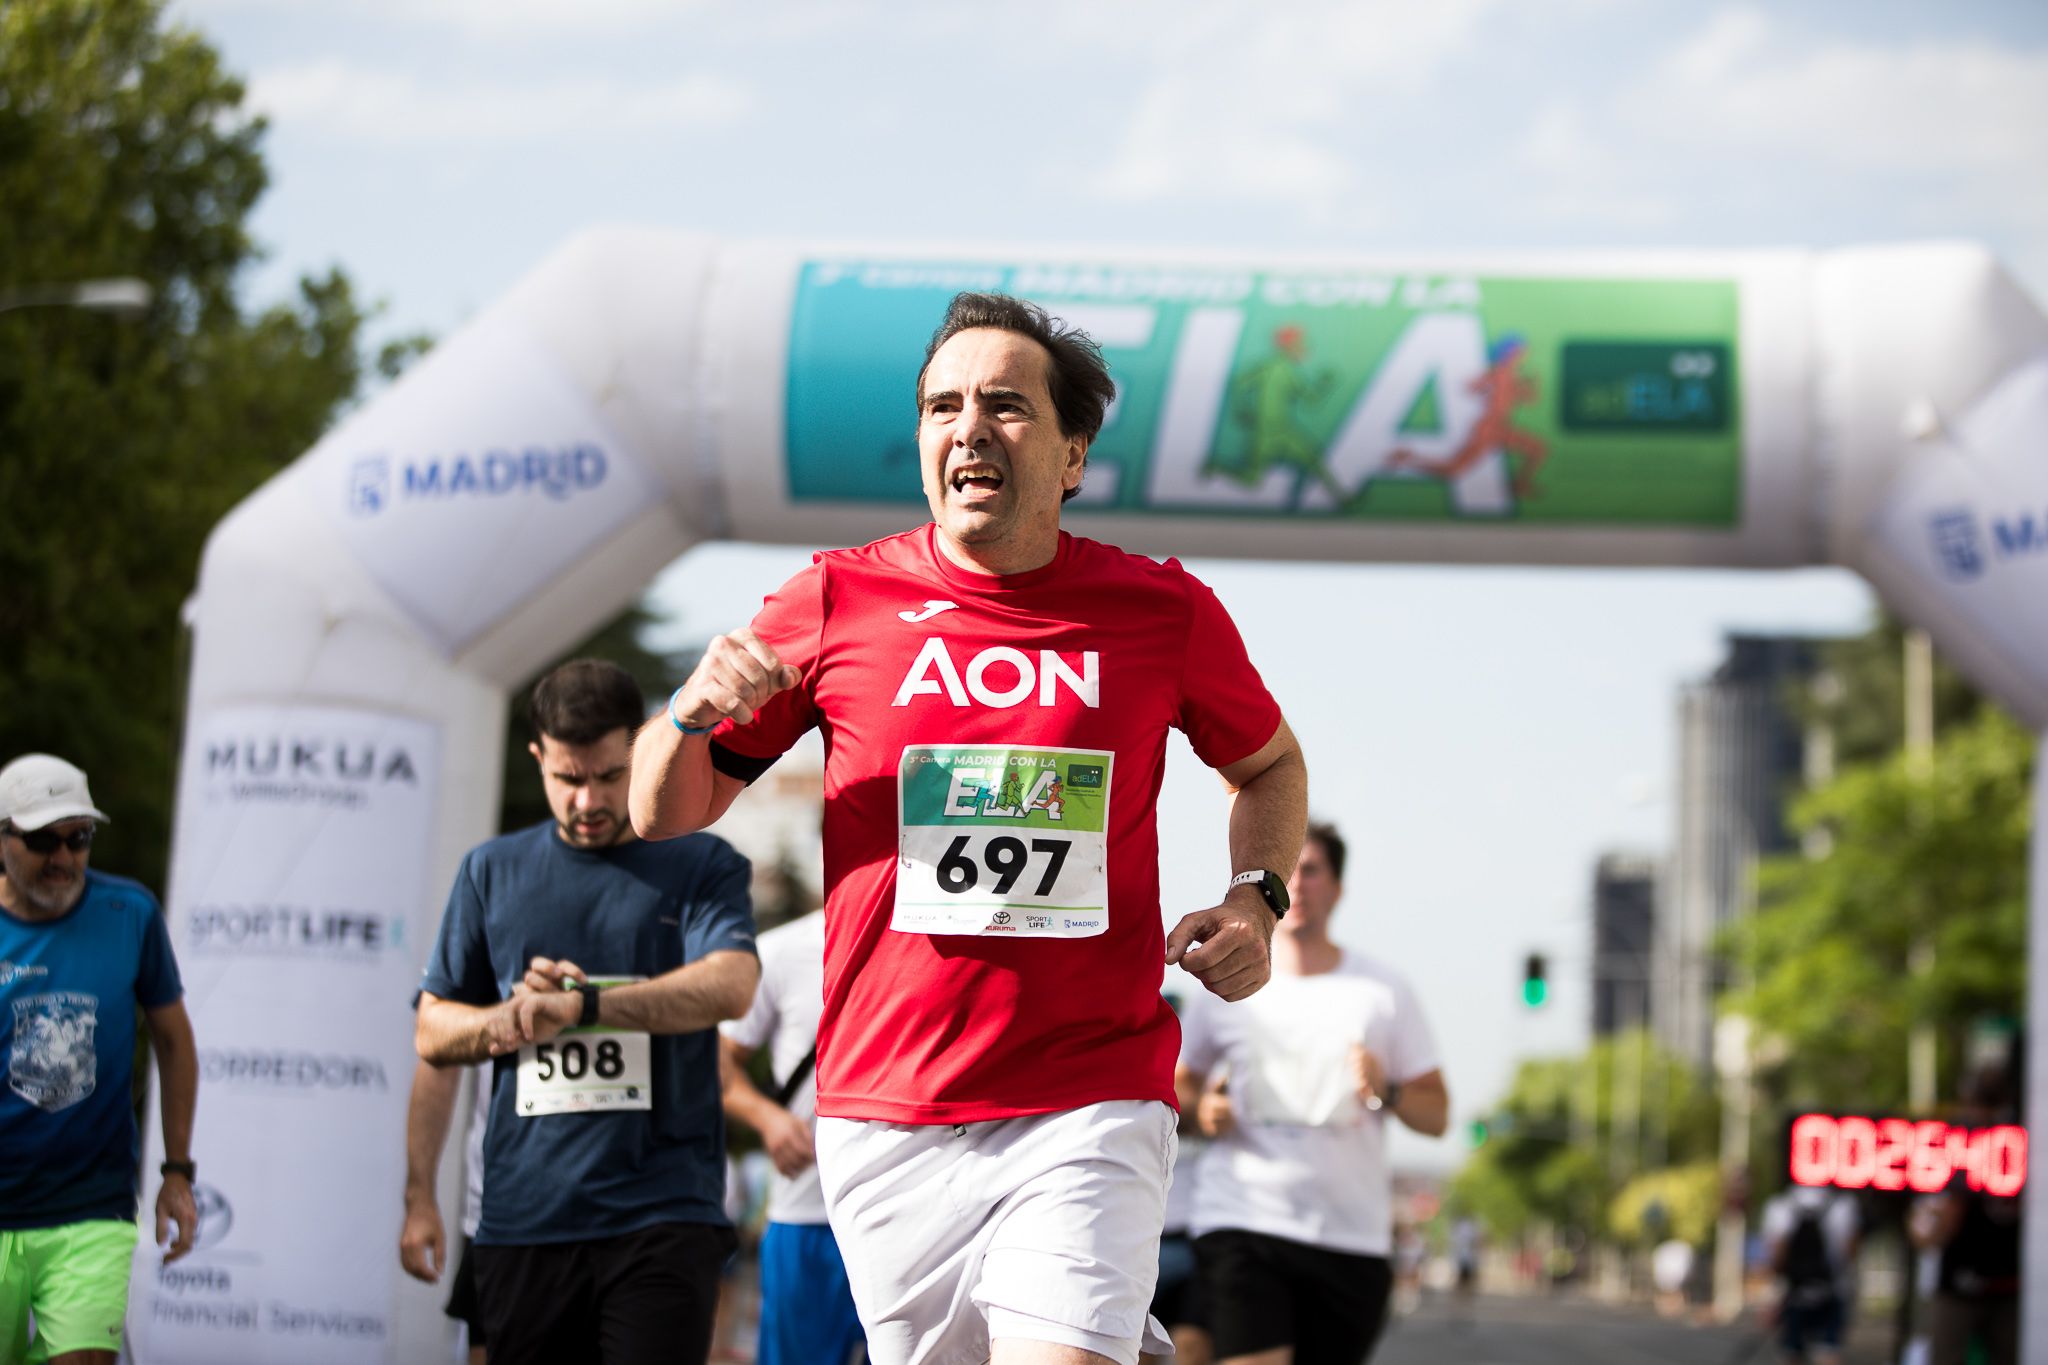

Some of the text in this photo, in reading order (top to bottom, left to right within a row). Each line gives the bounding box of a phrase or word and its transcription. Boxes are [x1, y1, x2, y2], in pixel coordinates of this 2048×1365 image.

[402, 441, 609, 501] MADRID
[891, 637, 1100, 708] AON
[206, 739, 418, 787] MUKUA
[953, 755, 1006, 767] MADRID
[1009, 756, 1037, 767] CON
[1040, 758, 1057, 768] LA
[943, 766, 1064, 821] ELA
[936, 835, 1073, 897] 697
[1072, 920, 1099, 928] MADRID
[535, 1038, 626, 1082] 508
[266, 1302, 386, 1339] Services
